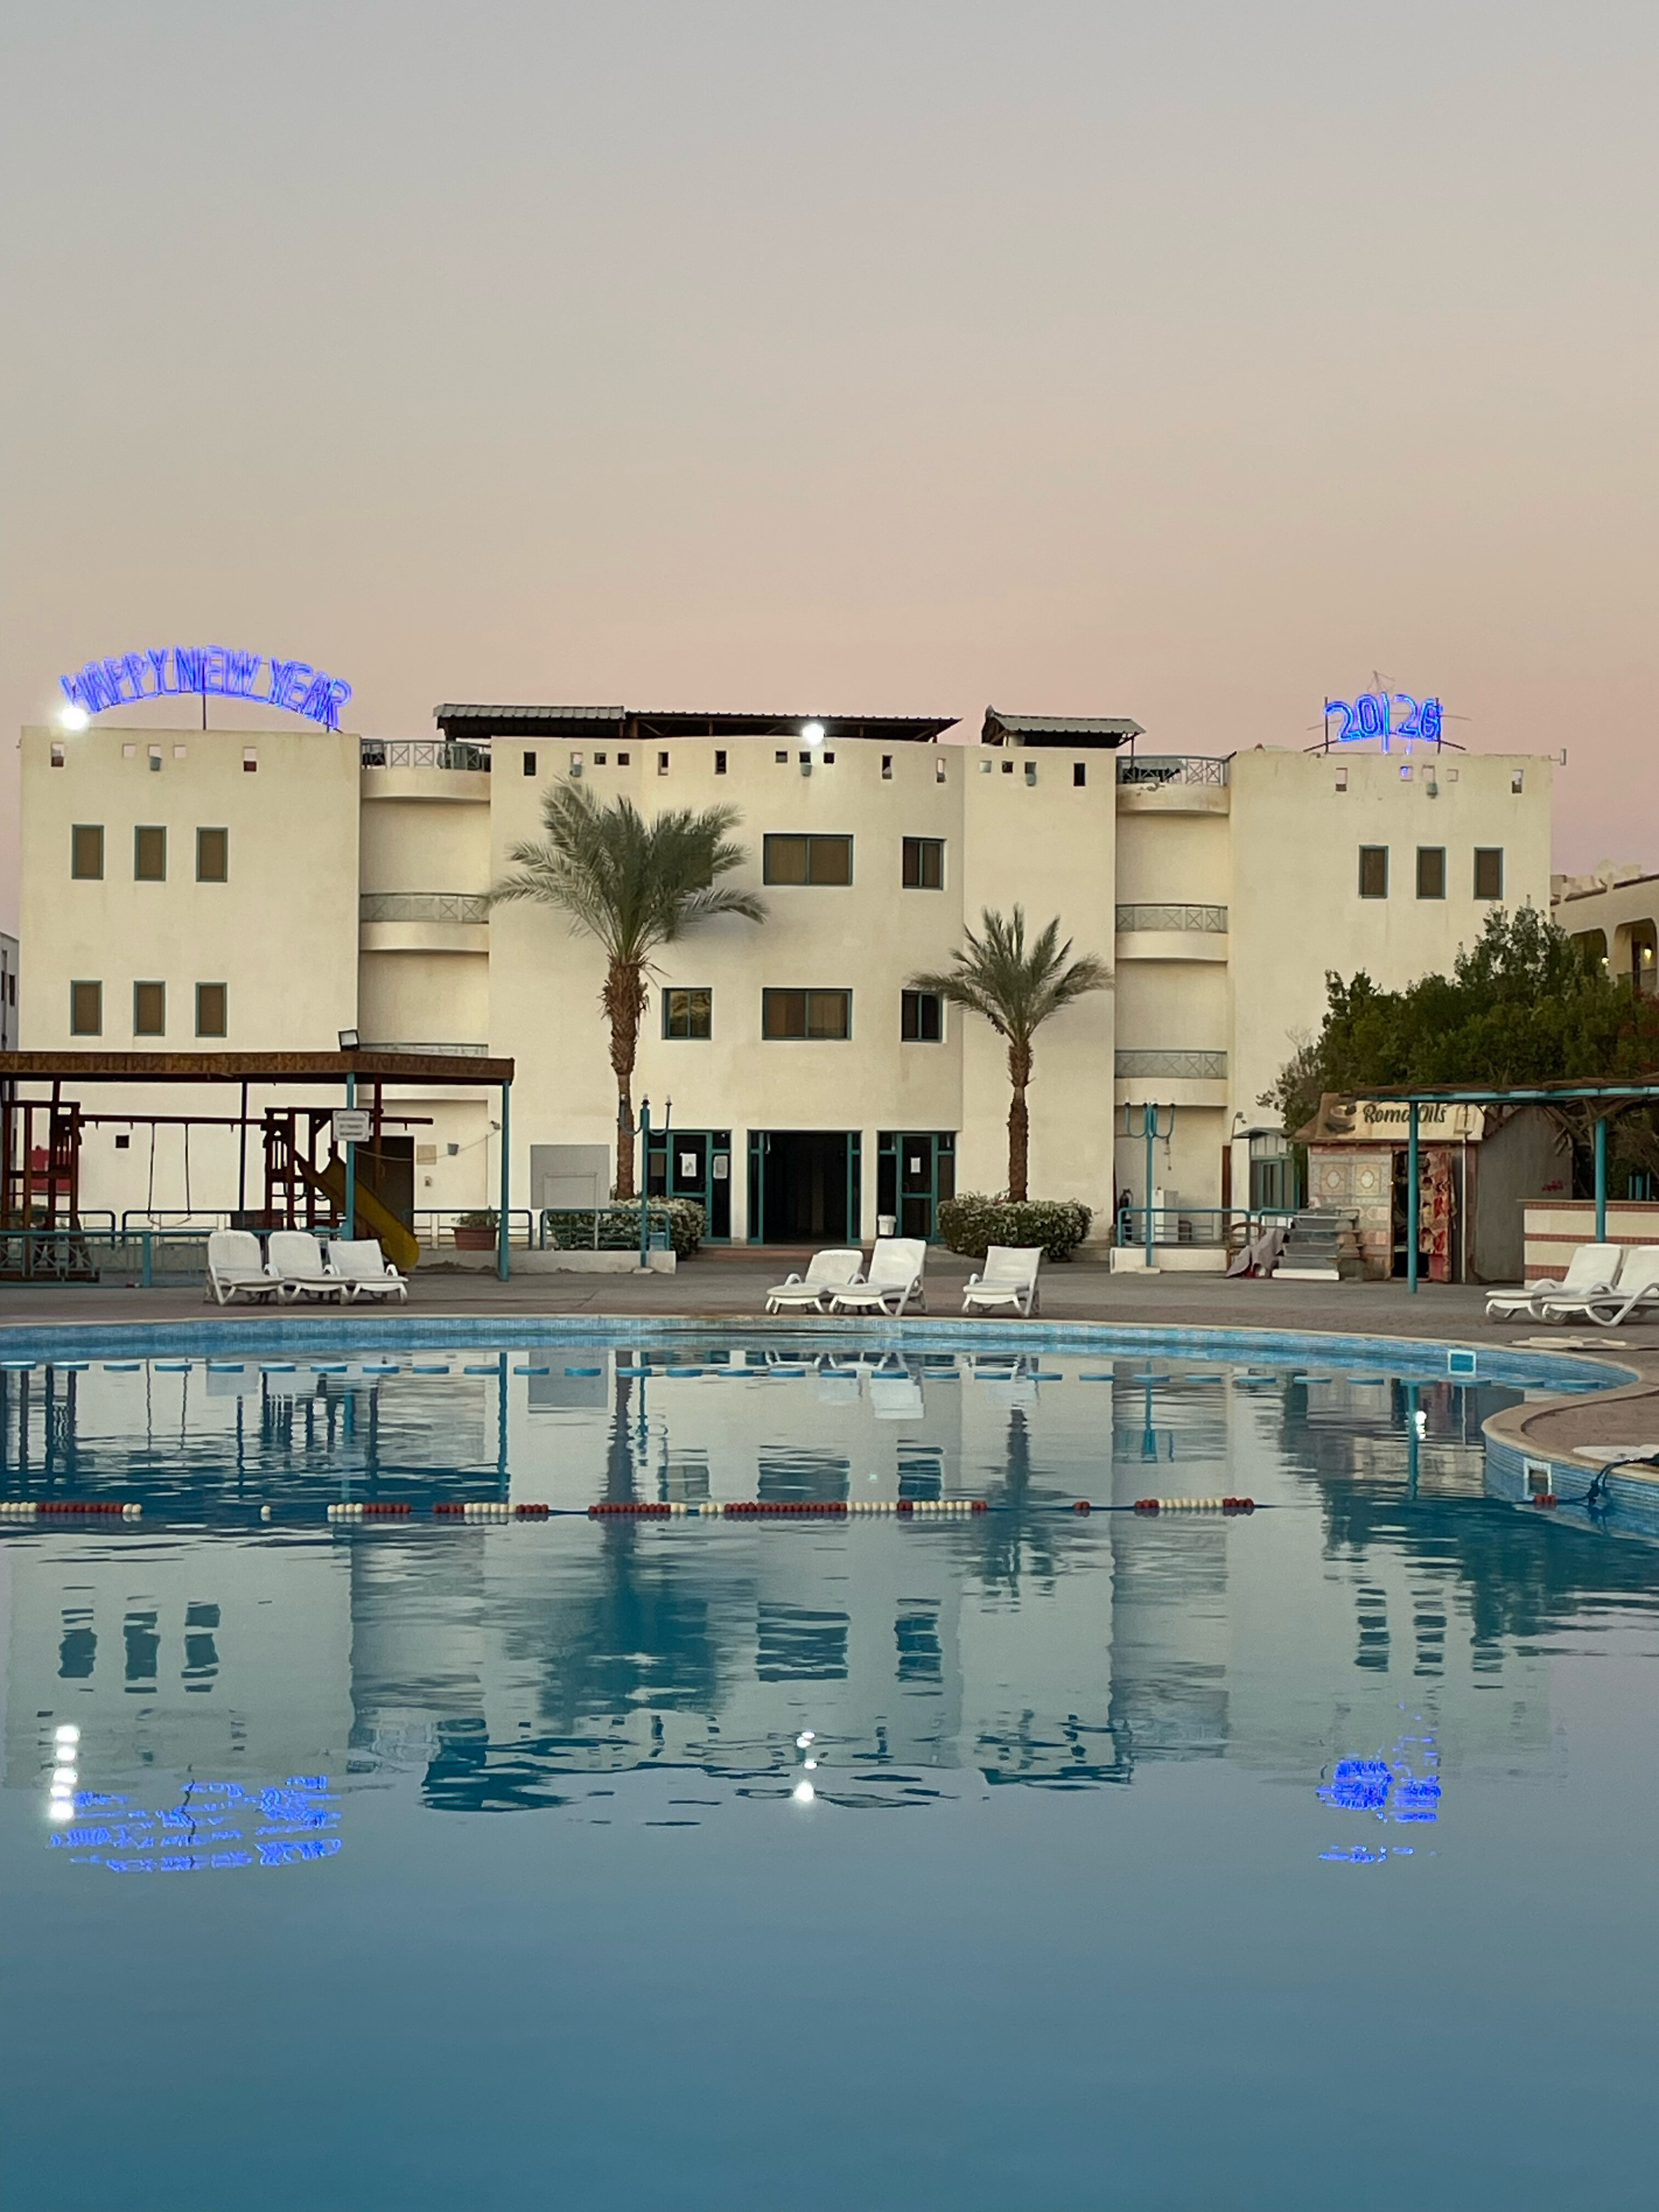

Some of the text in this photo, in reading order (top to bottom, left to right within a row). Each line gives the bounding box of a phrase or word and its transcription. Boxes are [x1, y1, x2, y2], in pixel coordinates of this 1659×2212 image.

[58, 644, 352, 730] HAPPY NEW YEAR
